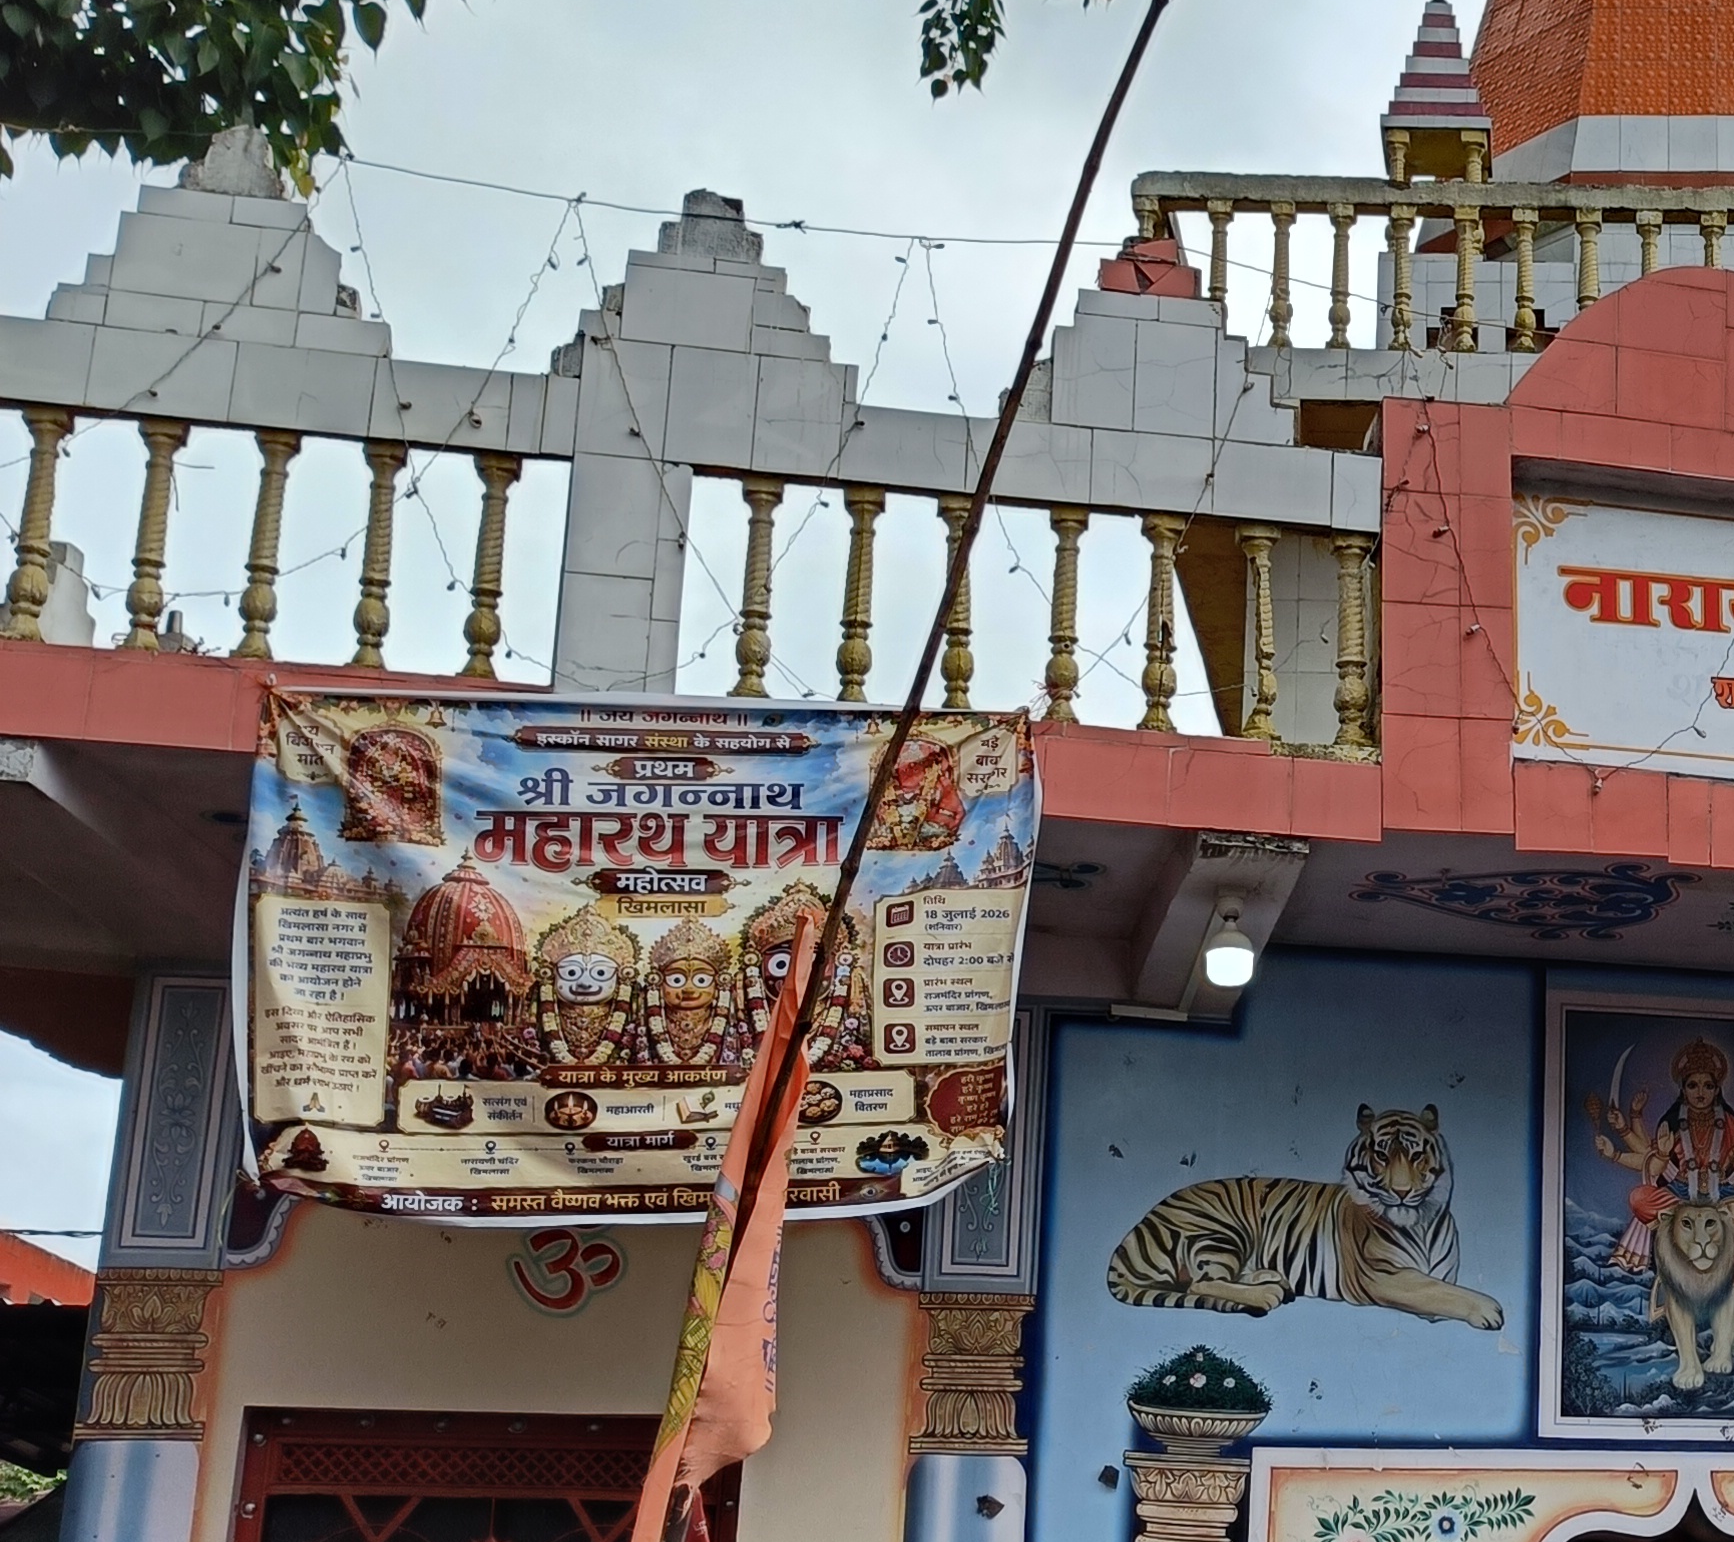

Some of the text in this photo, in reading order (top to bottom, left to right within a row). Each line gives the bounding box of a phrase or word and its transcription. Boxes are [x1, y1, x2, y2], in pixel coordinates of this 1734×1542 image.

[599, 711, 729, 726] जय जगन्नाथ
[536, 729, 791, 750] इस्कॉन सागर संस्था के सहयोग से
[633, 759, 695, 779] प्रथम
[516, 767, 804, 810] श्री जगन्नाथ
[473, 810, 845, 874] महारथ यात्रा
[616, 866, 708, 894] महोत्सव
[616, 897, 708, 915] खिमलासा
[924, 907, 1010, 922] 18 जुलाई 2026
[278, 918, 355, 933] खिमलासा नगर
[923, 942, 944, 950] यात्रा
[923, 955, 984, 966] दोपहर 2:00
[558, 1067, 727, 1087] यात्रा के मुख्य आकर्षण
[849, 1088, 894, 1098] महाप्रसाद
[482, 1095, 528, 1108] सत्संग एवं
[605, 1102, 655, 1115] महाआरती
[855, 1101, 887, 1112] वितरण
[606, 1131, 676, 1149] यात्रा मार्ग
[381, 1186, 668, 1211] आयोजक समस्त वैष्णव भक्त एवं
